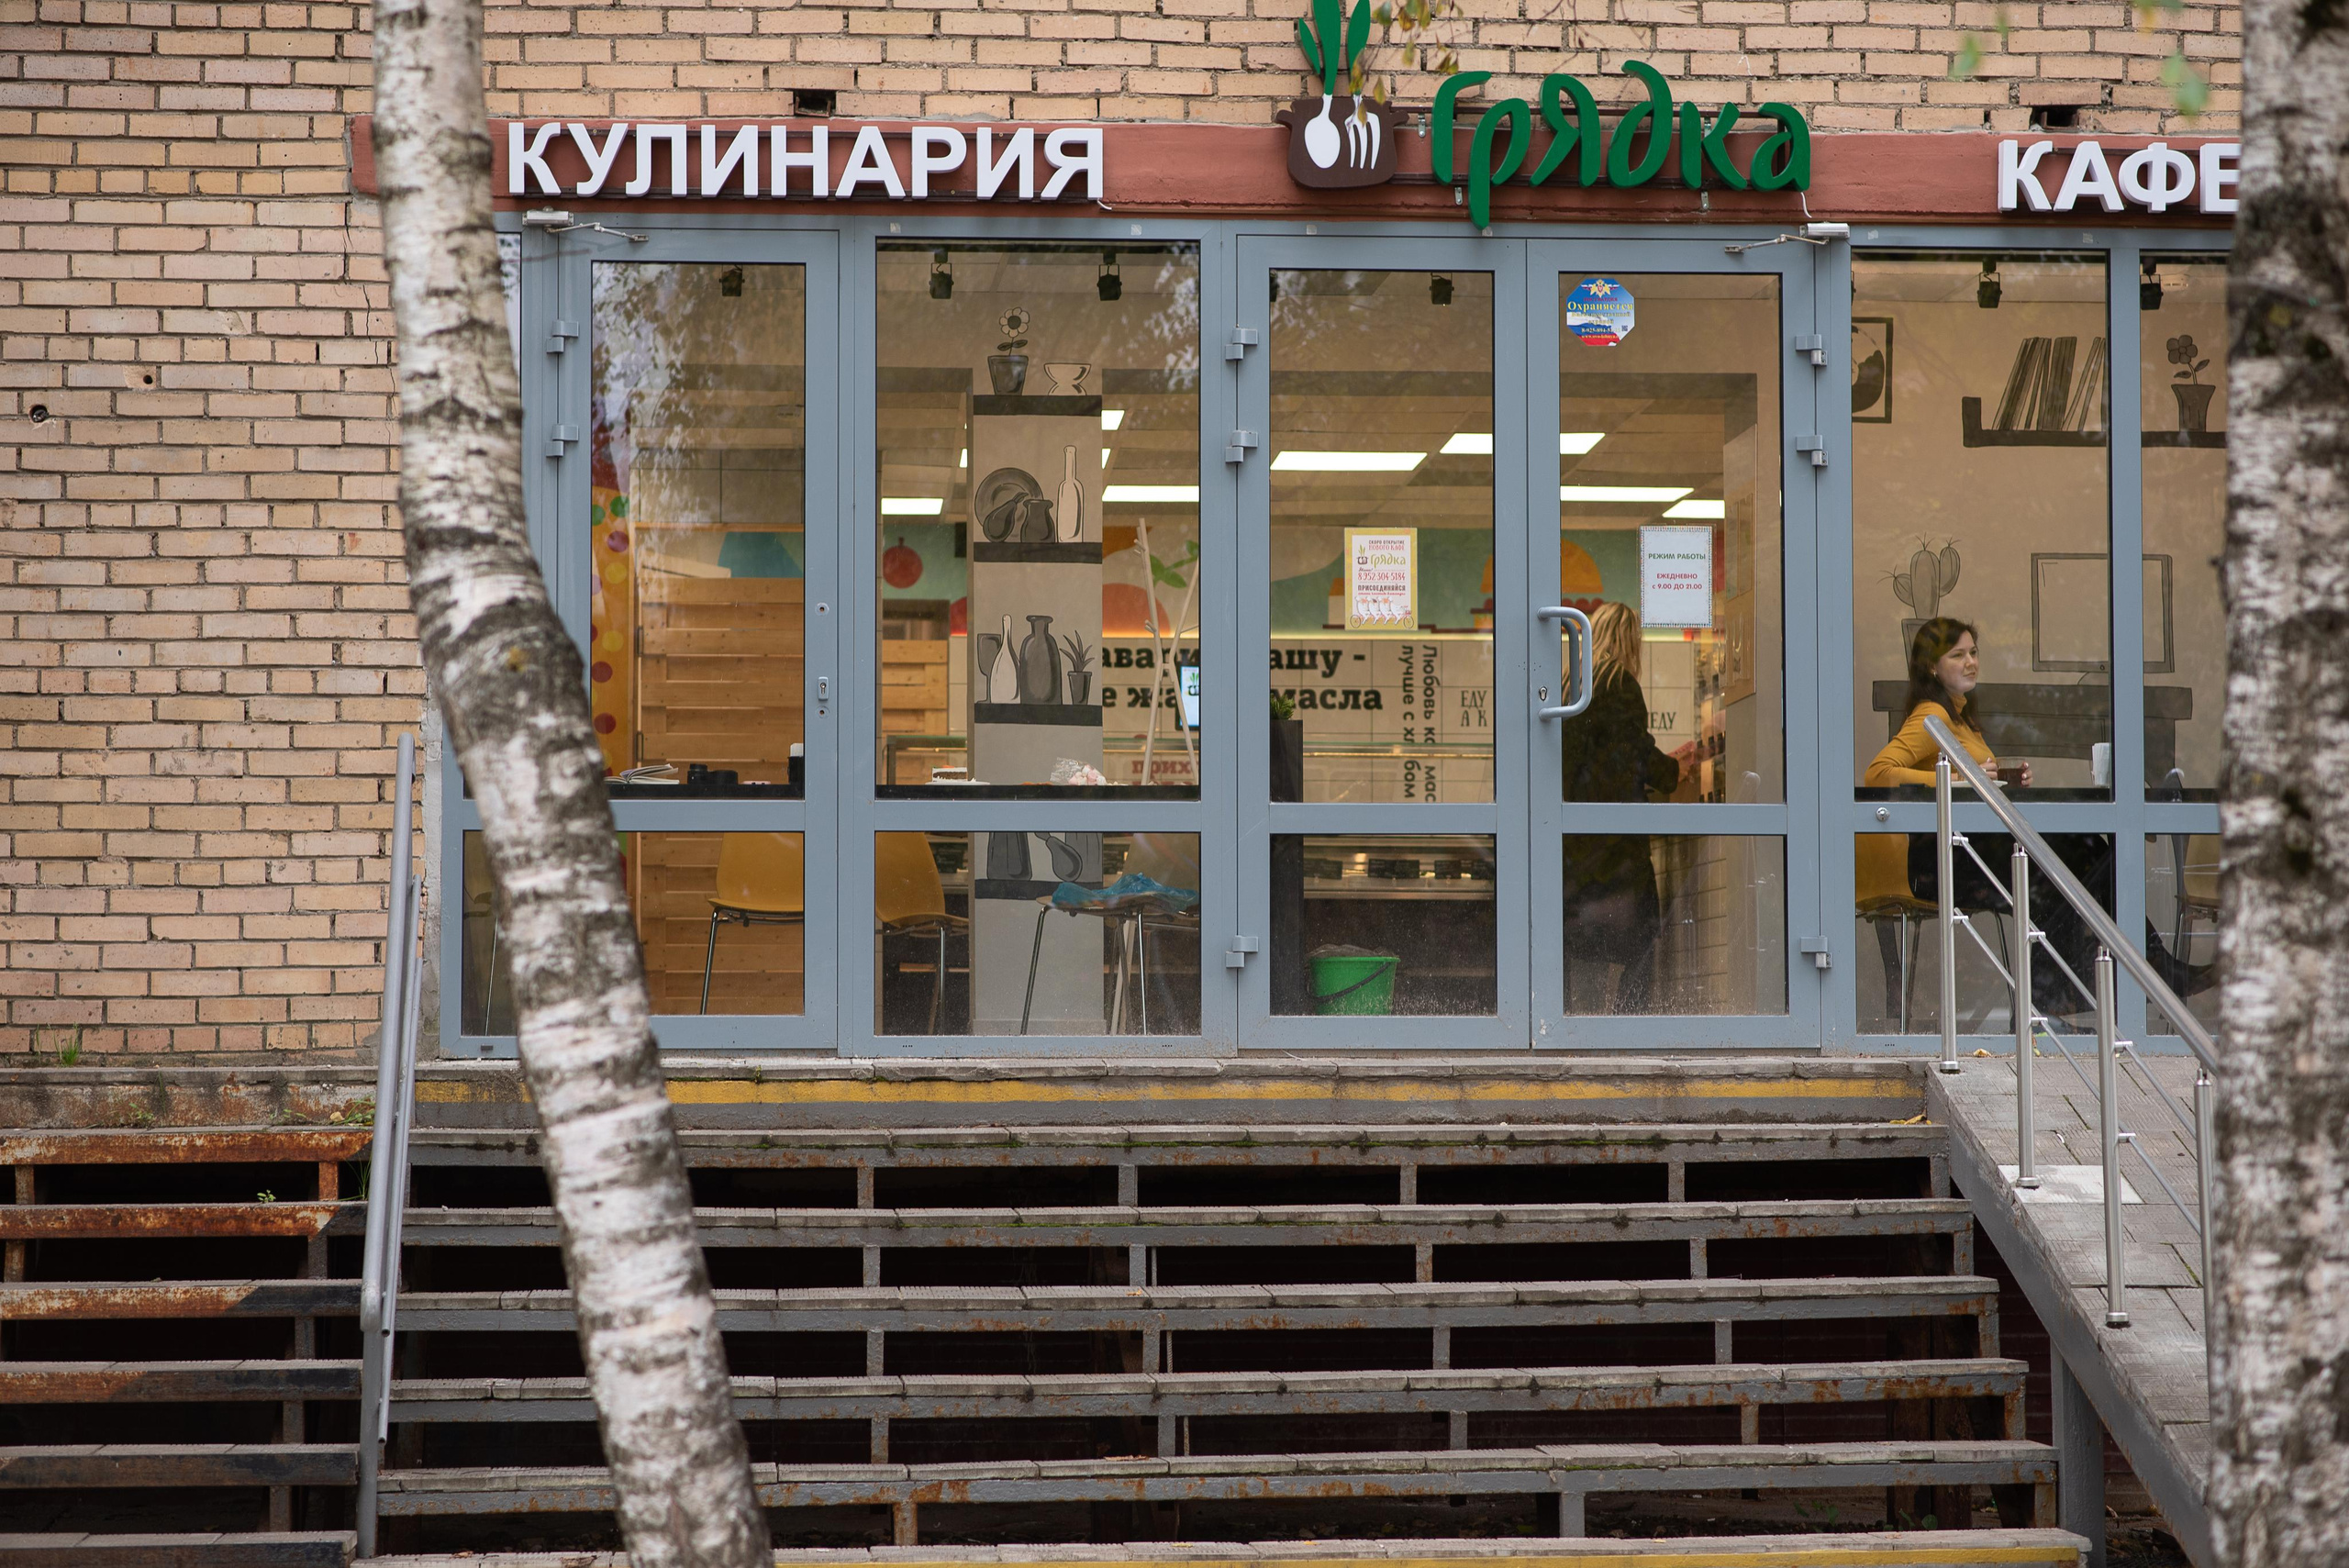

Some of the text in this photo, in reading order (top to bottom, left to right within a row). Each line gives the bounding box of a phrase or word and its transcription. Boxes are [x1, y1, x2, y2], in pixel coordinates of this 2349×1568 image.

[508, 122, 1103, 200] КУЛИНАРИЯ
[1431, 60, 1810, 230] Грядка
[1998, 139, 2241, 214] КАФЕ
[1567, 301, 1633, 313] Охраняется
[1358, 572, 1406, 581] 8 952 304 5184
[1358, 584, 1406, 592] ПРИСОЕДИНЯЙСЯ
[1398, 645, 1414, 705] лучше
[1423, 644, 1441, 720] Любовь
[1403, 711, 1414, 721] с
